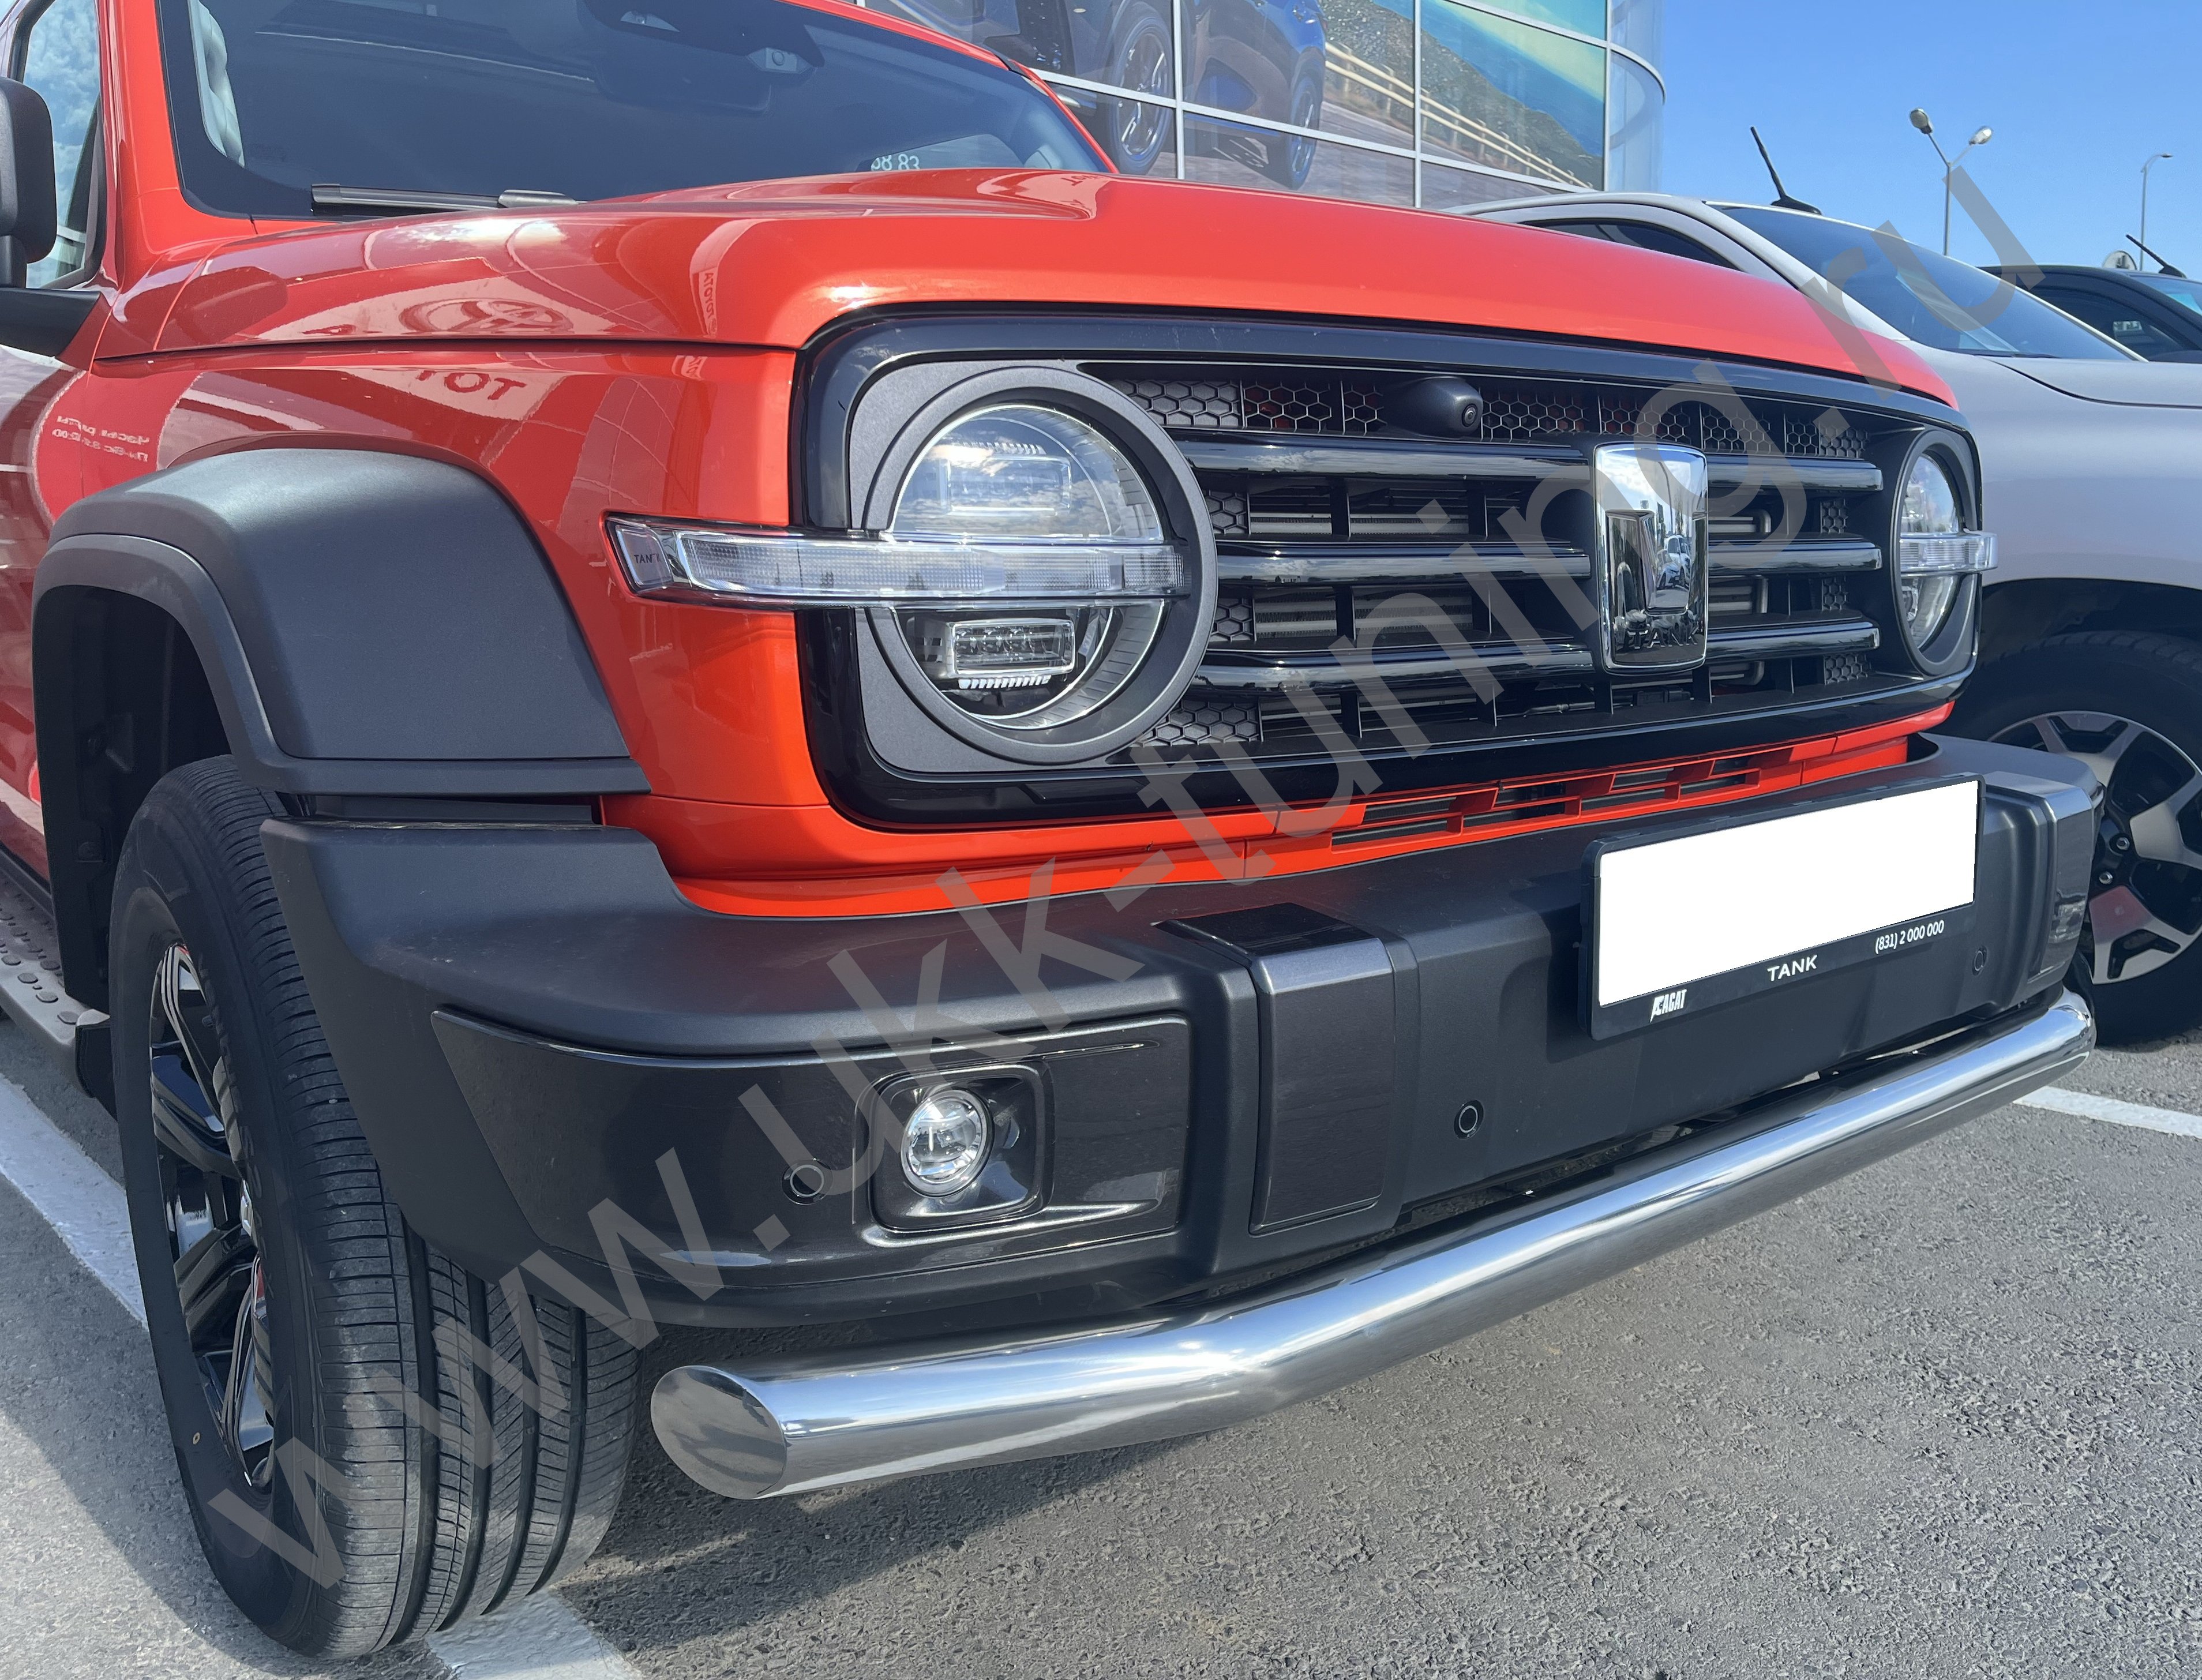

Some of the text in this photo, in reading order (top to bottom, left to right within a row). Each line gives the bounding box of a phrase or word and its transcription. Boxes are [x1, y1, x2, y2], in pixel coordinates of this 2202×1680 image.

[1875, 920, 1944, 954] (831) 2 000 000
[1767, 955, 1817, 981] TANK
